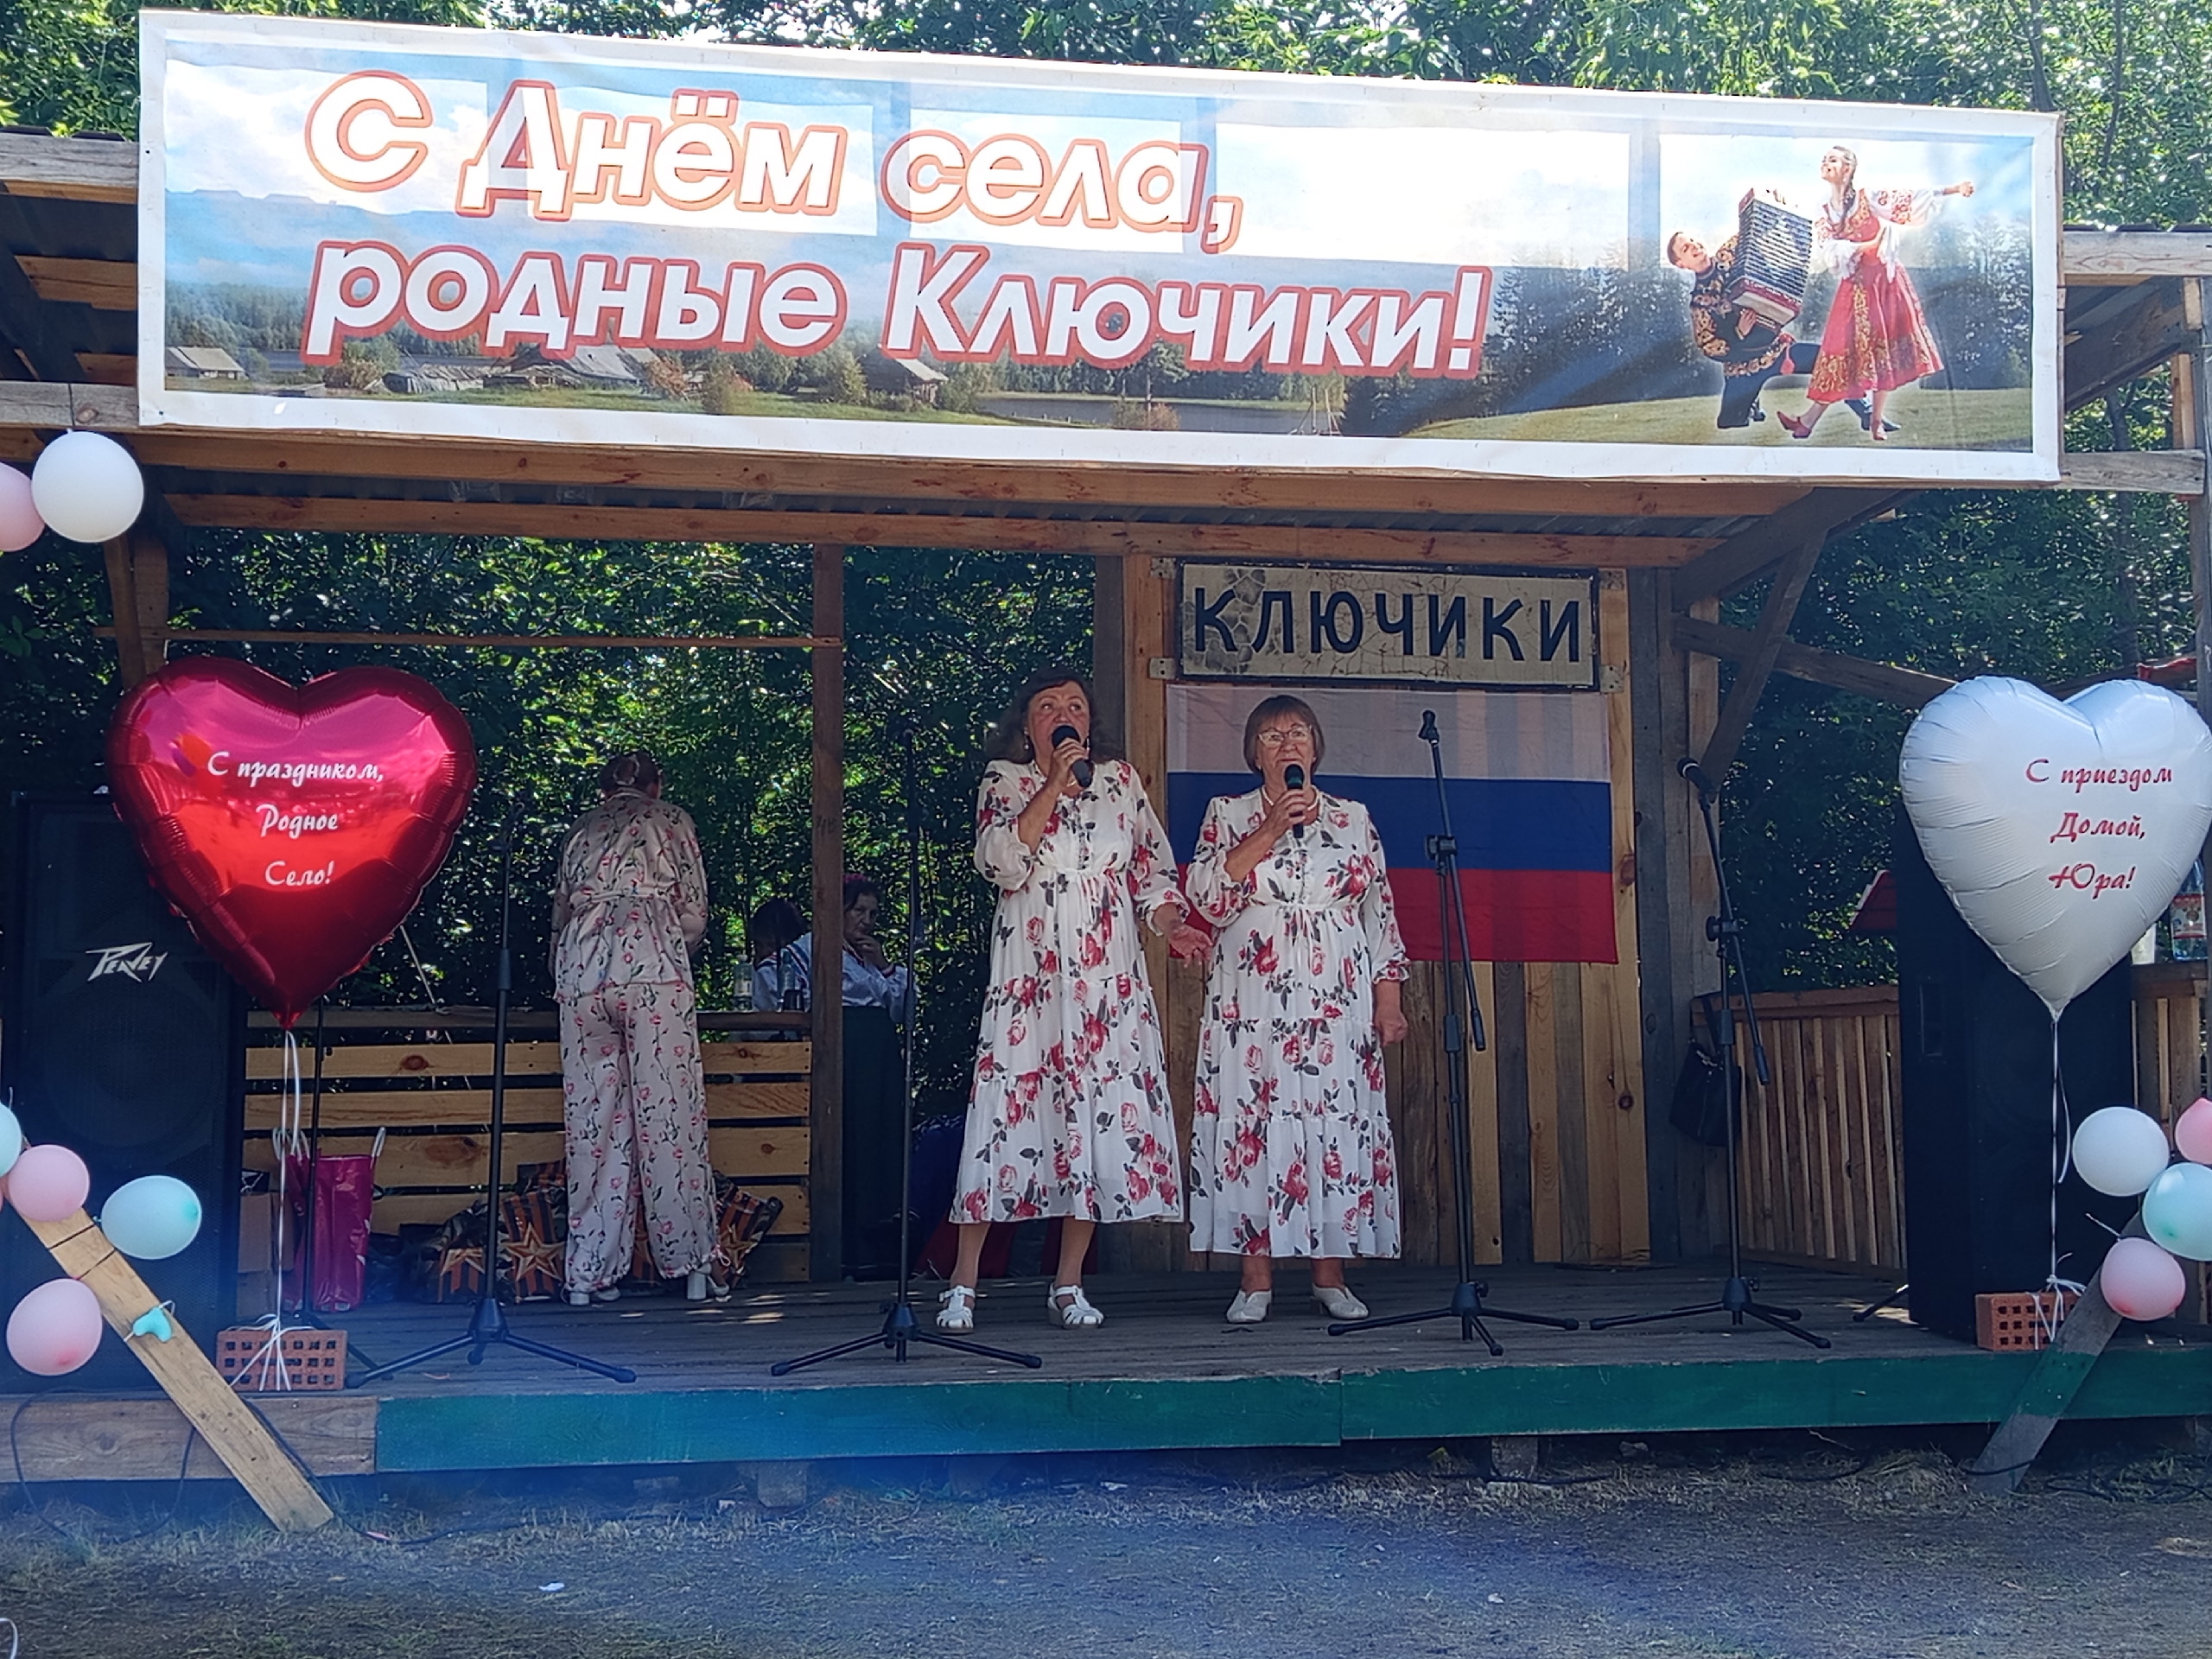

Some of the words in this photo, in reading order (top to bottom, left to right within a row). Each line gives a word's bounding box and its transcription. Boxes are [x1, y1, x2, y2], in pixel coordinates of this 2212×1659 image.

[306, 70, 433, 193] С
[455, 80, 848, 221] Днём
[880, 130, 1243, 254] села,
[301, 240, 848, 366] родные
[880, 242, 1491, 379] Ключики!
[1193, 586, 1580, 664] КЛЮЧИКИ
[207, 751, 230, 776] С
[237, 761, 384, 787] праздником,
[2025, 758, 2050, 783] С
[2061, 766, 2172, 793] приездом
[256, 804, 339, 839] Родное
[2050, 812, 2146, 843] Домой,
[265, 861, 335, 887] Село!
[2048, 862, 2136, 900] Юра!
